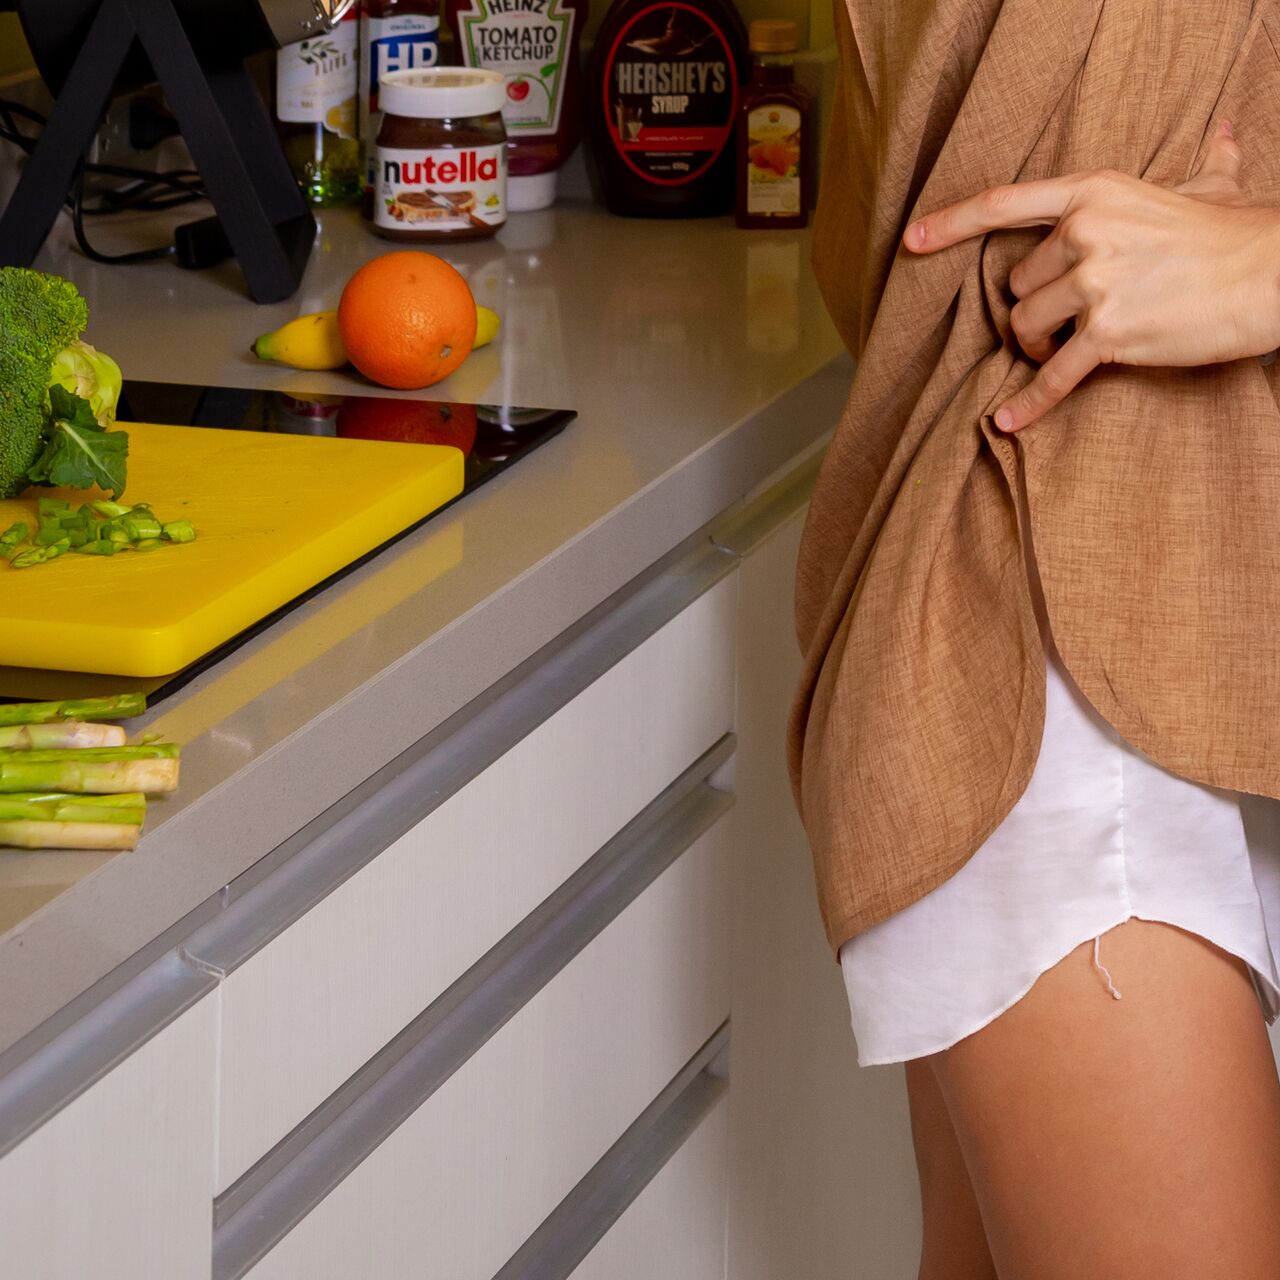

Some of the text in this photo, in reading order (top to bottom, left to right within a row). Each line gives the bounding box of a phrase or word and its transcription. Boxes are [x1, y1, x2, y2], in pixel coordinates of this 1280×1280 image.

[477, 26, 557, 46] TOMATO
[376, 42, 438, 81] HP
[482, 45, 554, 61] KETCHUP
[618, 62, 726, 95] HERSHEY'S
[651, 95, 689, 114] SYRUP
[384, 151, 497, 184] nutella
